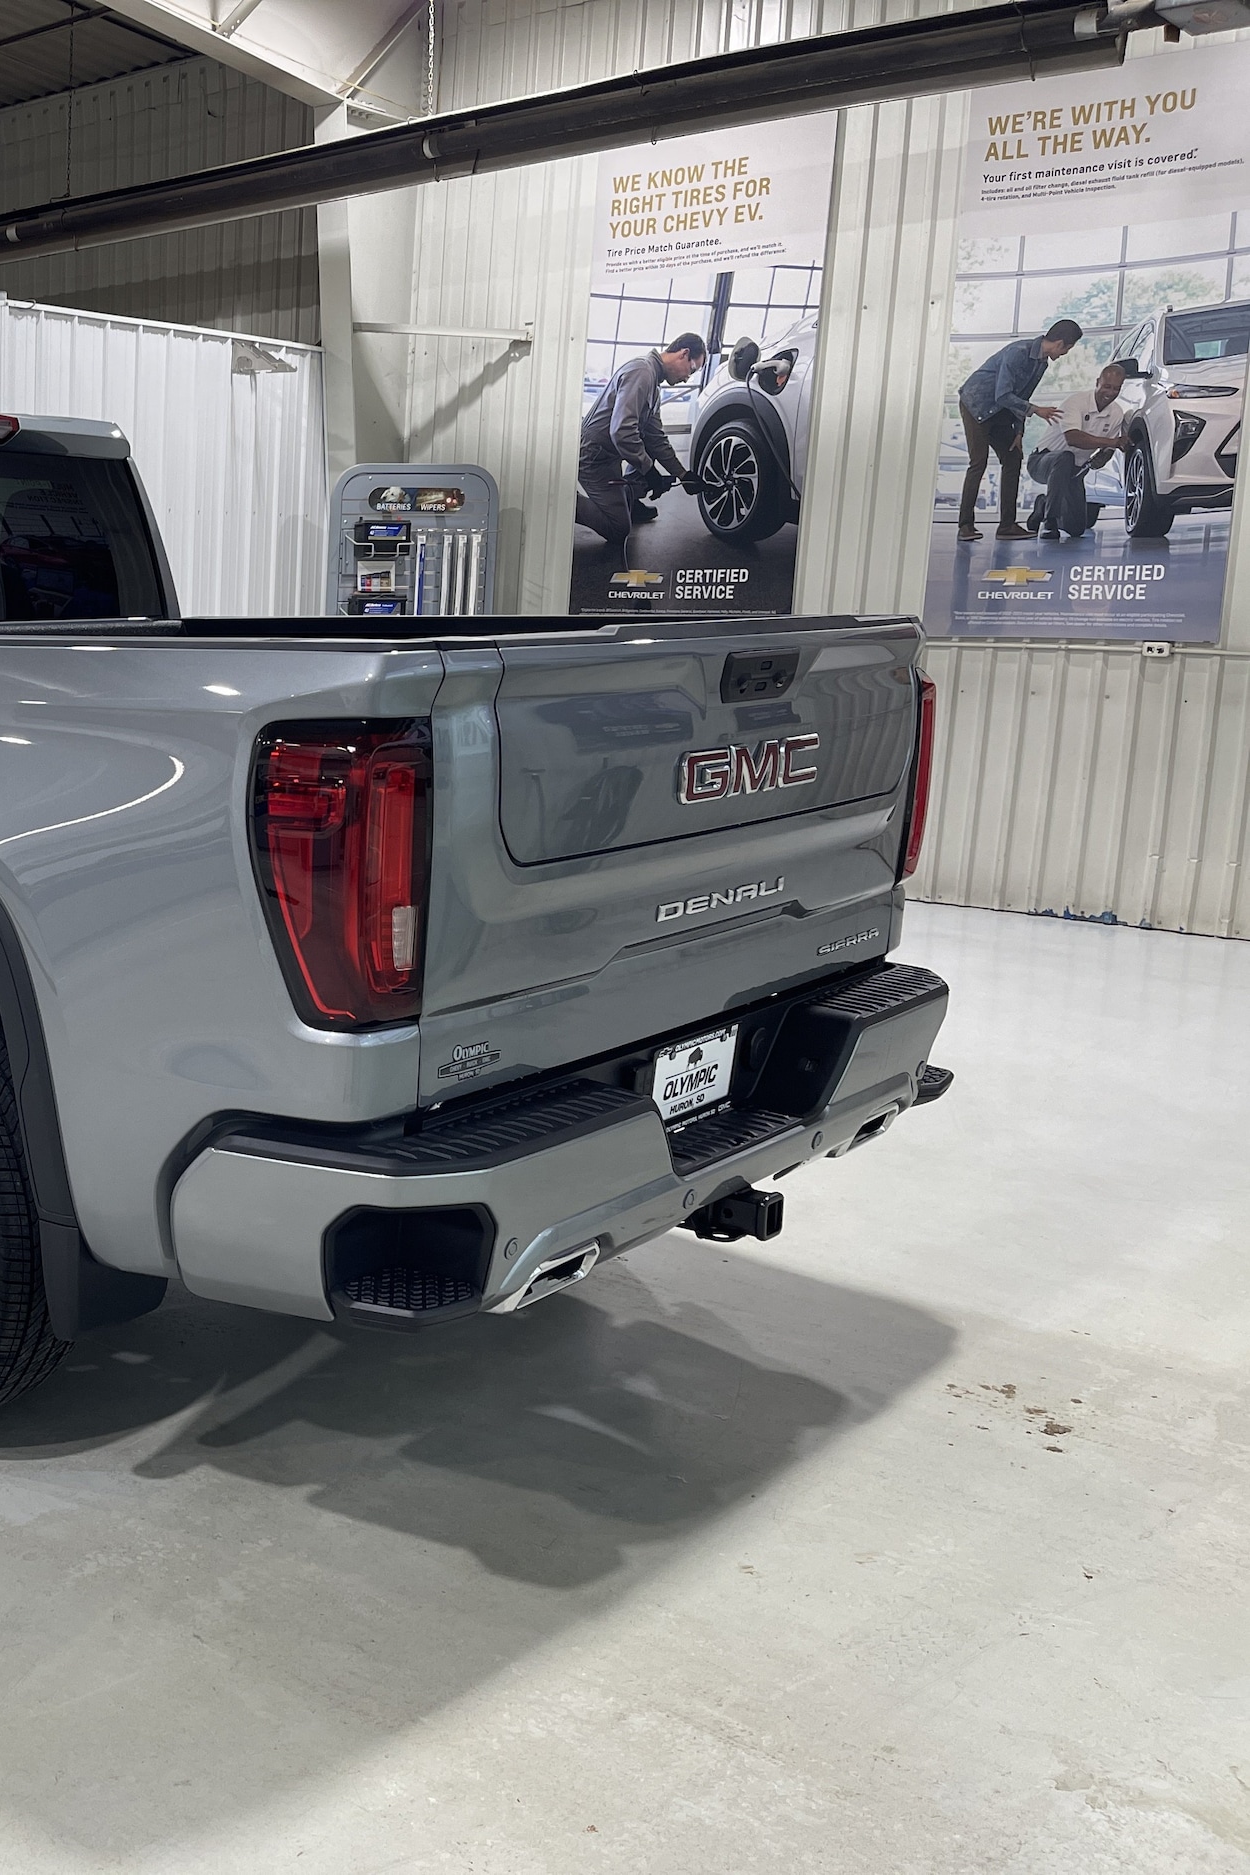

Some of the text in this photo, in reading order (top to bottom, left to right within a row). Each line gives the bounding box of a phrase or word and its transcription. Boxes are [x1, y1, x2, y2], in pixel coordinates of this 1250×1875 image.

[988, 88, 1197, 136] WE'RE WITH YOU
[984, 123, 1151, 162] ALL THE WAY.
[613, 156, 750, 194] WE KNOW THE
[983, 174, 1007, 183] Your
[1009, 171, 1032, 181] first
[1035, 163, 1105, 179] maintenance
[1107, 158, 1132, 170] visit
[1134, 157, 1144, 167] is
[611, 177, 771, 217] RIGHT TIRES FOR
[1064, 187, 1084, 195] Vehicle
[609, 202, 764, 239] YOUR CHEVY EV.
[607, 238, 722, 257] Tire Price Match Guarantee.
[376, 502, 411, 511] BATTERIES
[420, 503, 446, 511] WIPERS
[676, 568, 749, 583] CERTIFIED
[1069, 564, 1166, 581] CERTIFIED
[608, 591, 665, 600] CHEVROLET
[674, 585, 735, 600] SERVICE
[977, 591, 1054, 600] CHEVROLET
[1067, 584, 1147, 600] SERVICE
[677, 732, 820, 805] GMC
[656, 875, 785, 923] DENALI
[816, 927, 880, 957] SIERRA
[663, 1063, 718, 1101] OLYMPIC
[670, 1093, 705, 1115] HURON, SD
